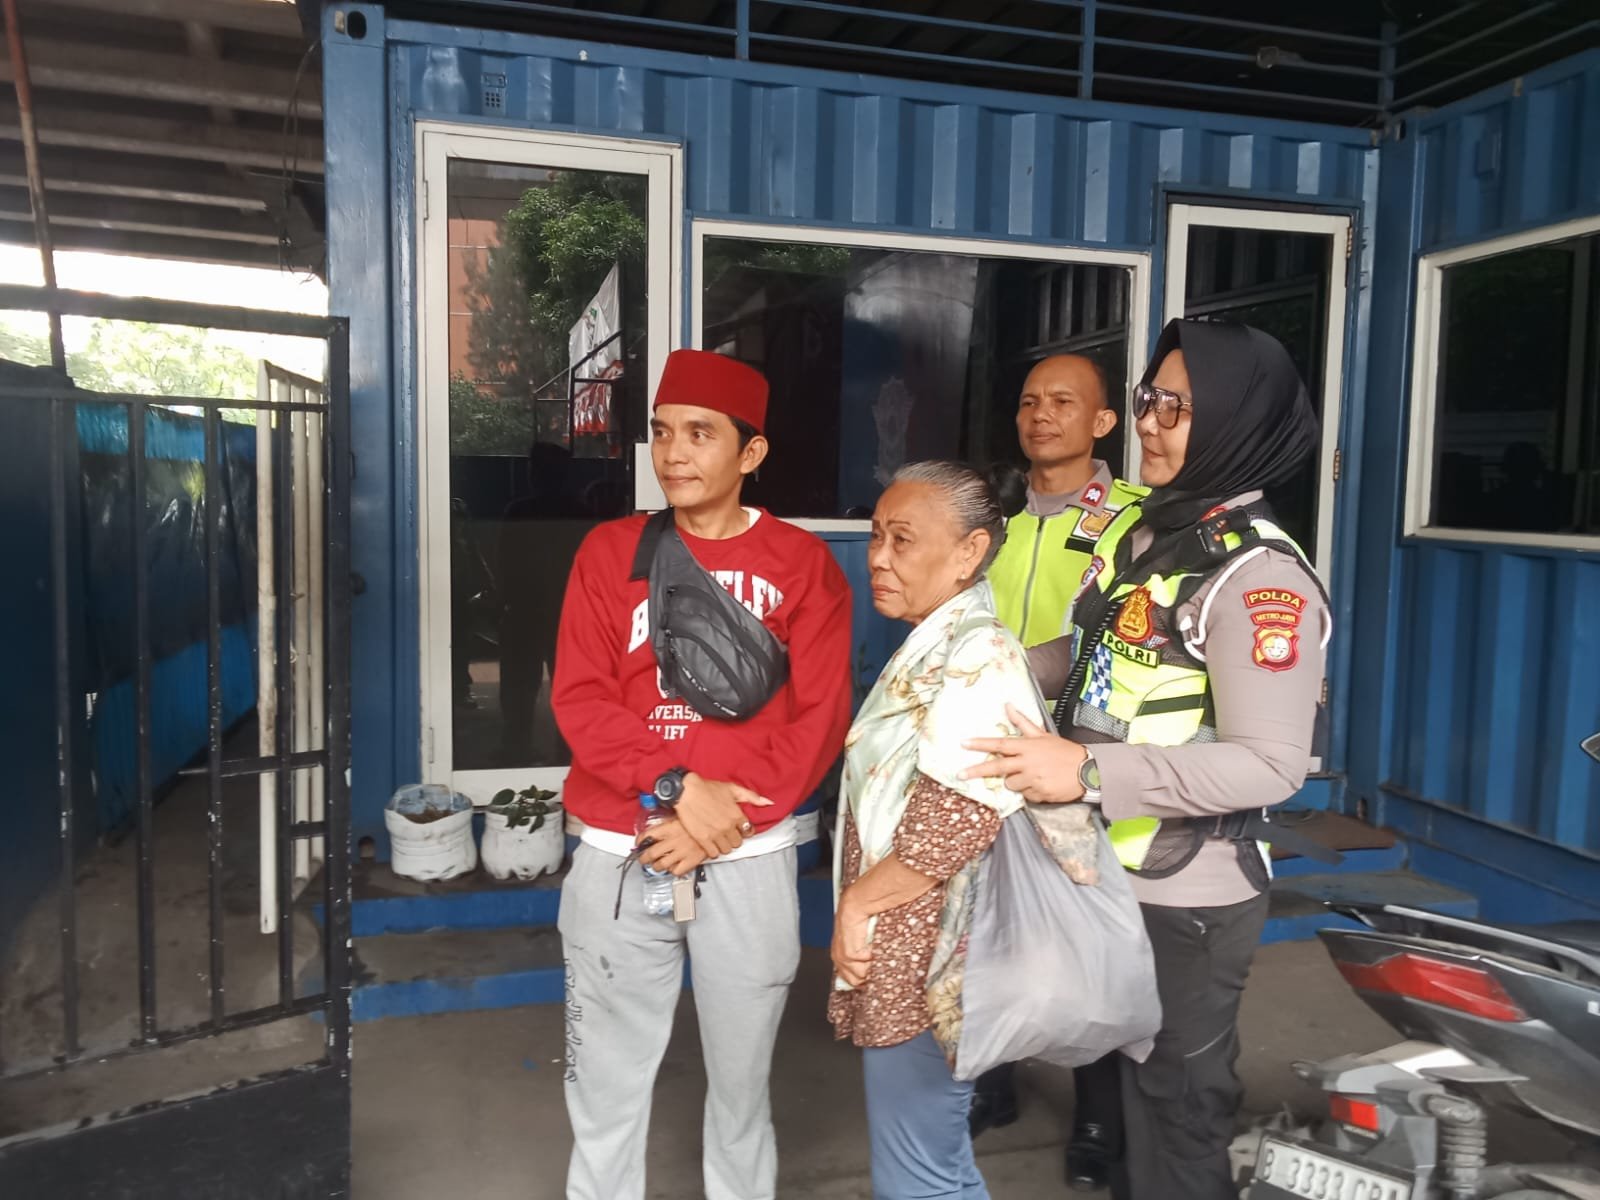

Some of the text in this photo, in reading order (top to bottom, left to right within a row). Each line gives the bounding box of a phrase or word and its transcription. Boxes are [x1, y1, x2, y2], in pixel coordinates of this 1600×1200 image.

[1249, 591, 1300, 607] POLDA
[1107, 634, 1151, 663] POLRI
[1264, 1148, 1275, 1180] B
[1287, 1157, 1344, 1200] 3333
